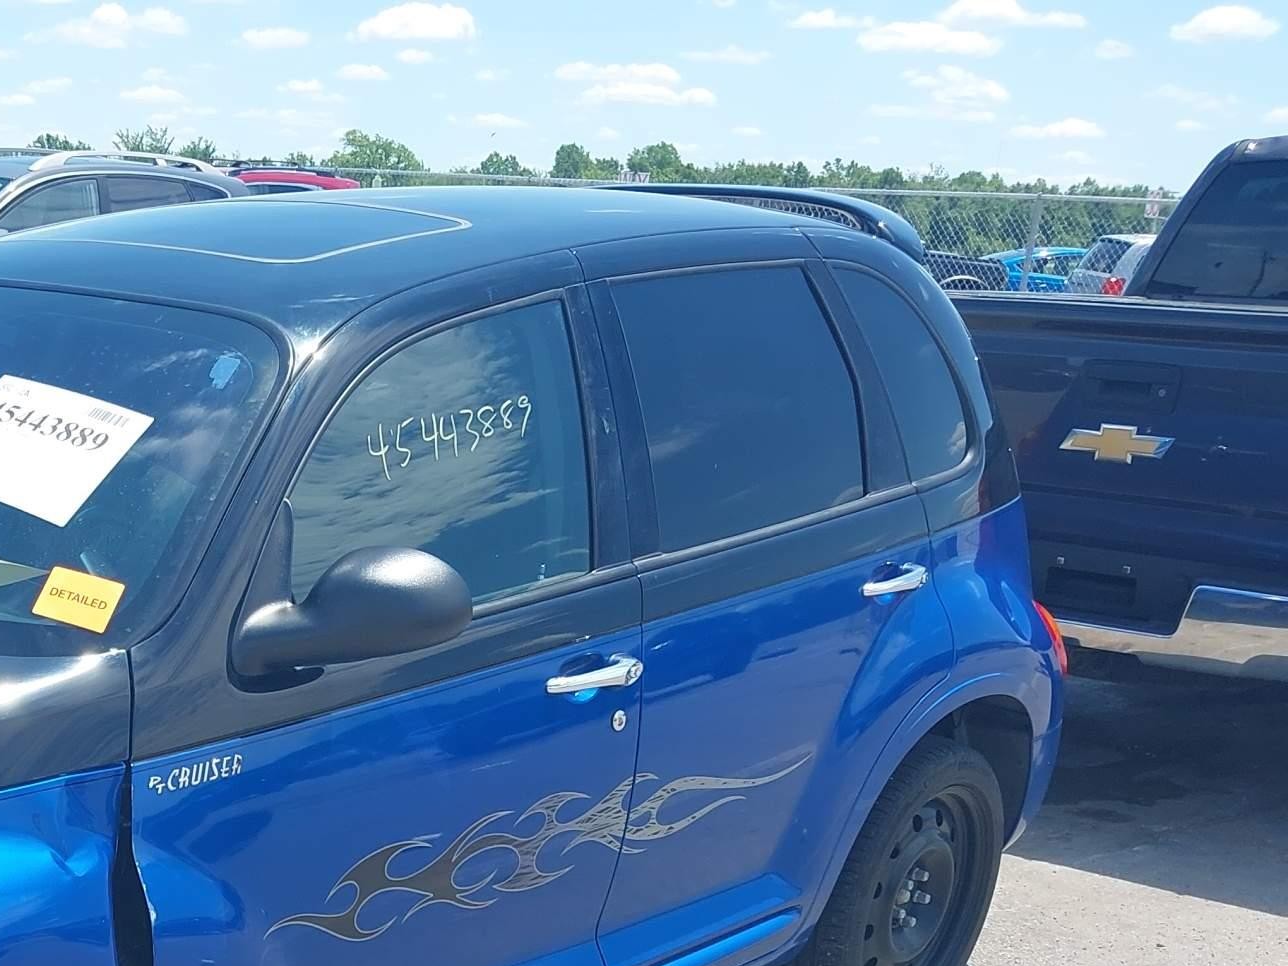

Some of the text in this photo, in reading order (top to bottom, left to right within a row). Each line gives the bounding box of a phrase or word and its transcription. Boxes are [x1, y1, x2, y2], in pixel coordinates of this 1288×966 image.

[367, 395, 532, 480] 45443889
[49, 587, 108, 610] DETAILED
[148, 754, 242, 794] PT CRUISER
